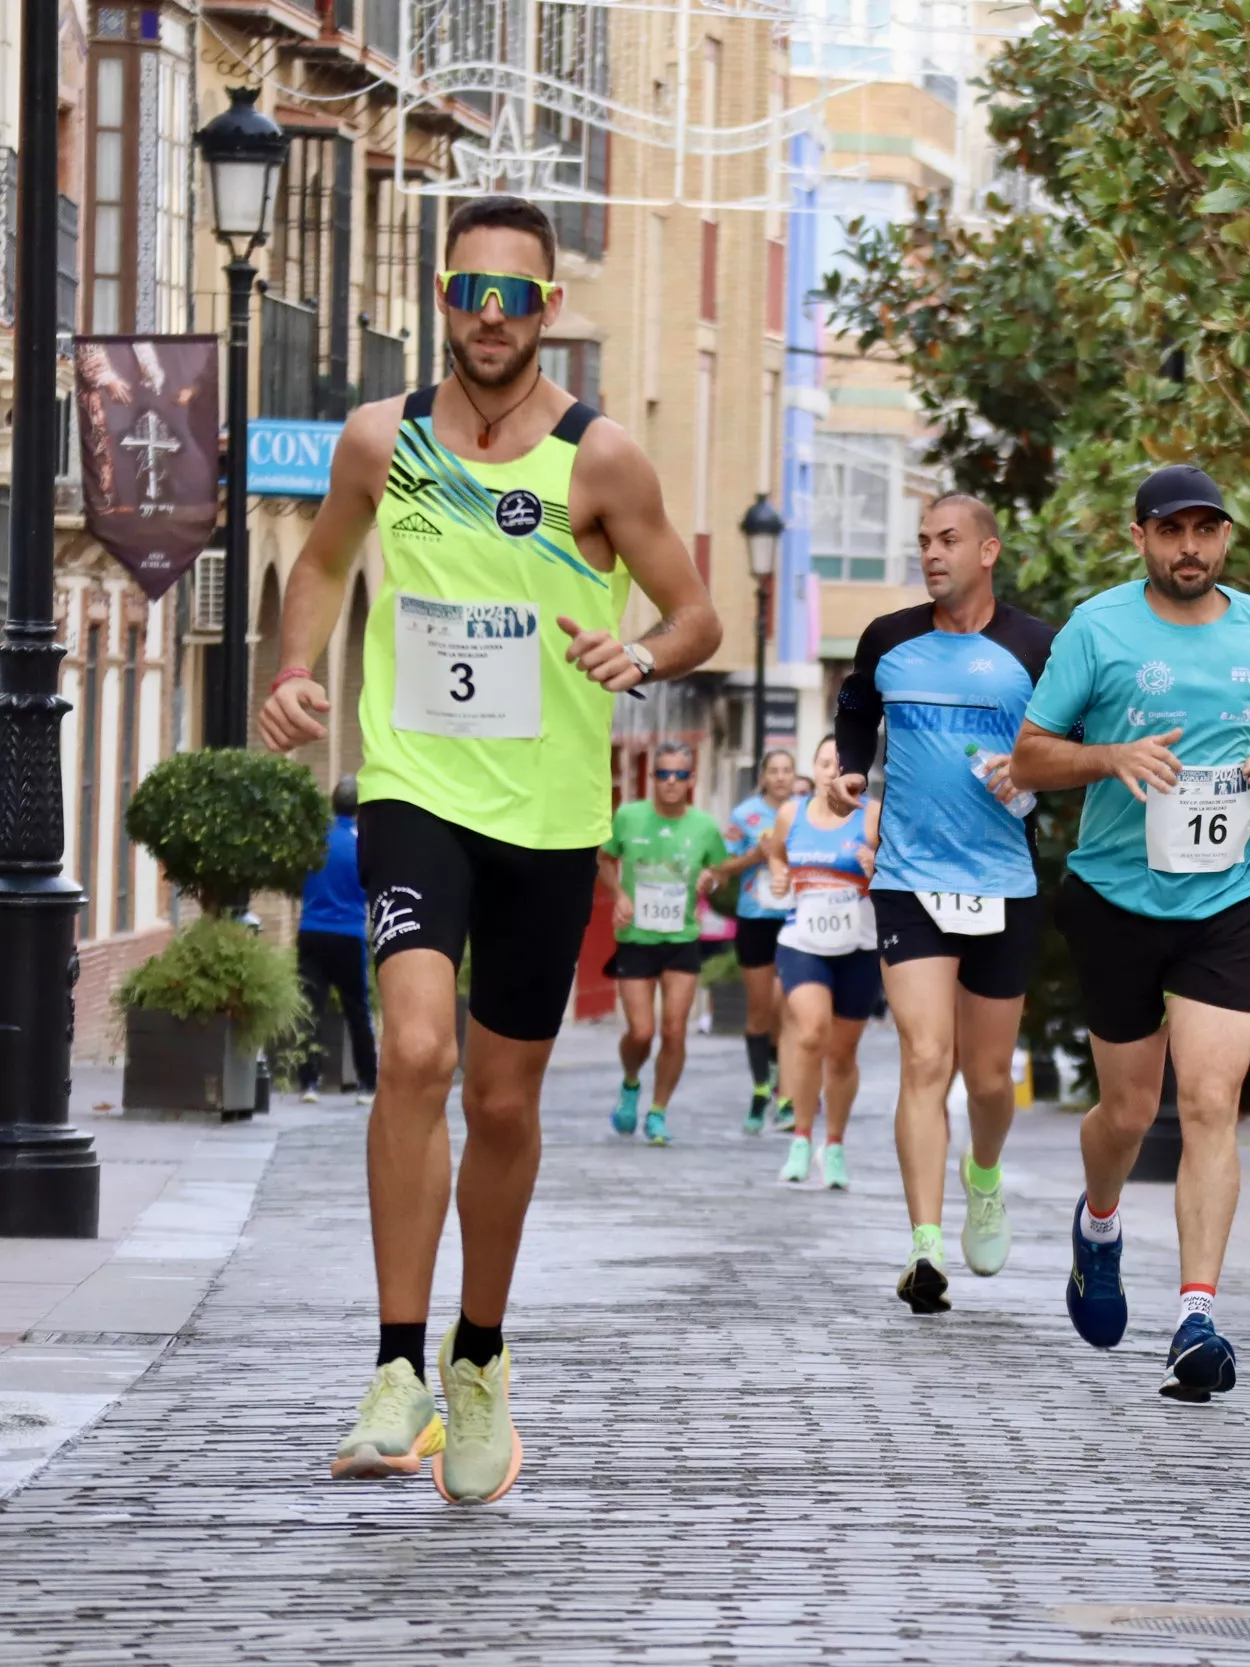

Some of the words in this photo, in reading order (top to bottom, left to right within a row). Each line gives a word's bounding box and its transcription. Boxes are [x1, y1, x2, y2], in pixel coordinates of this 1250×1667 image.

[449, 662, 476, 703] 3
[1188, 813, 1228, 846] 16
[642, 903, 680, 920] 1305
[807, 913, 851, 934] 1001
